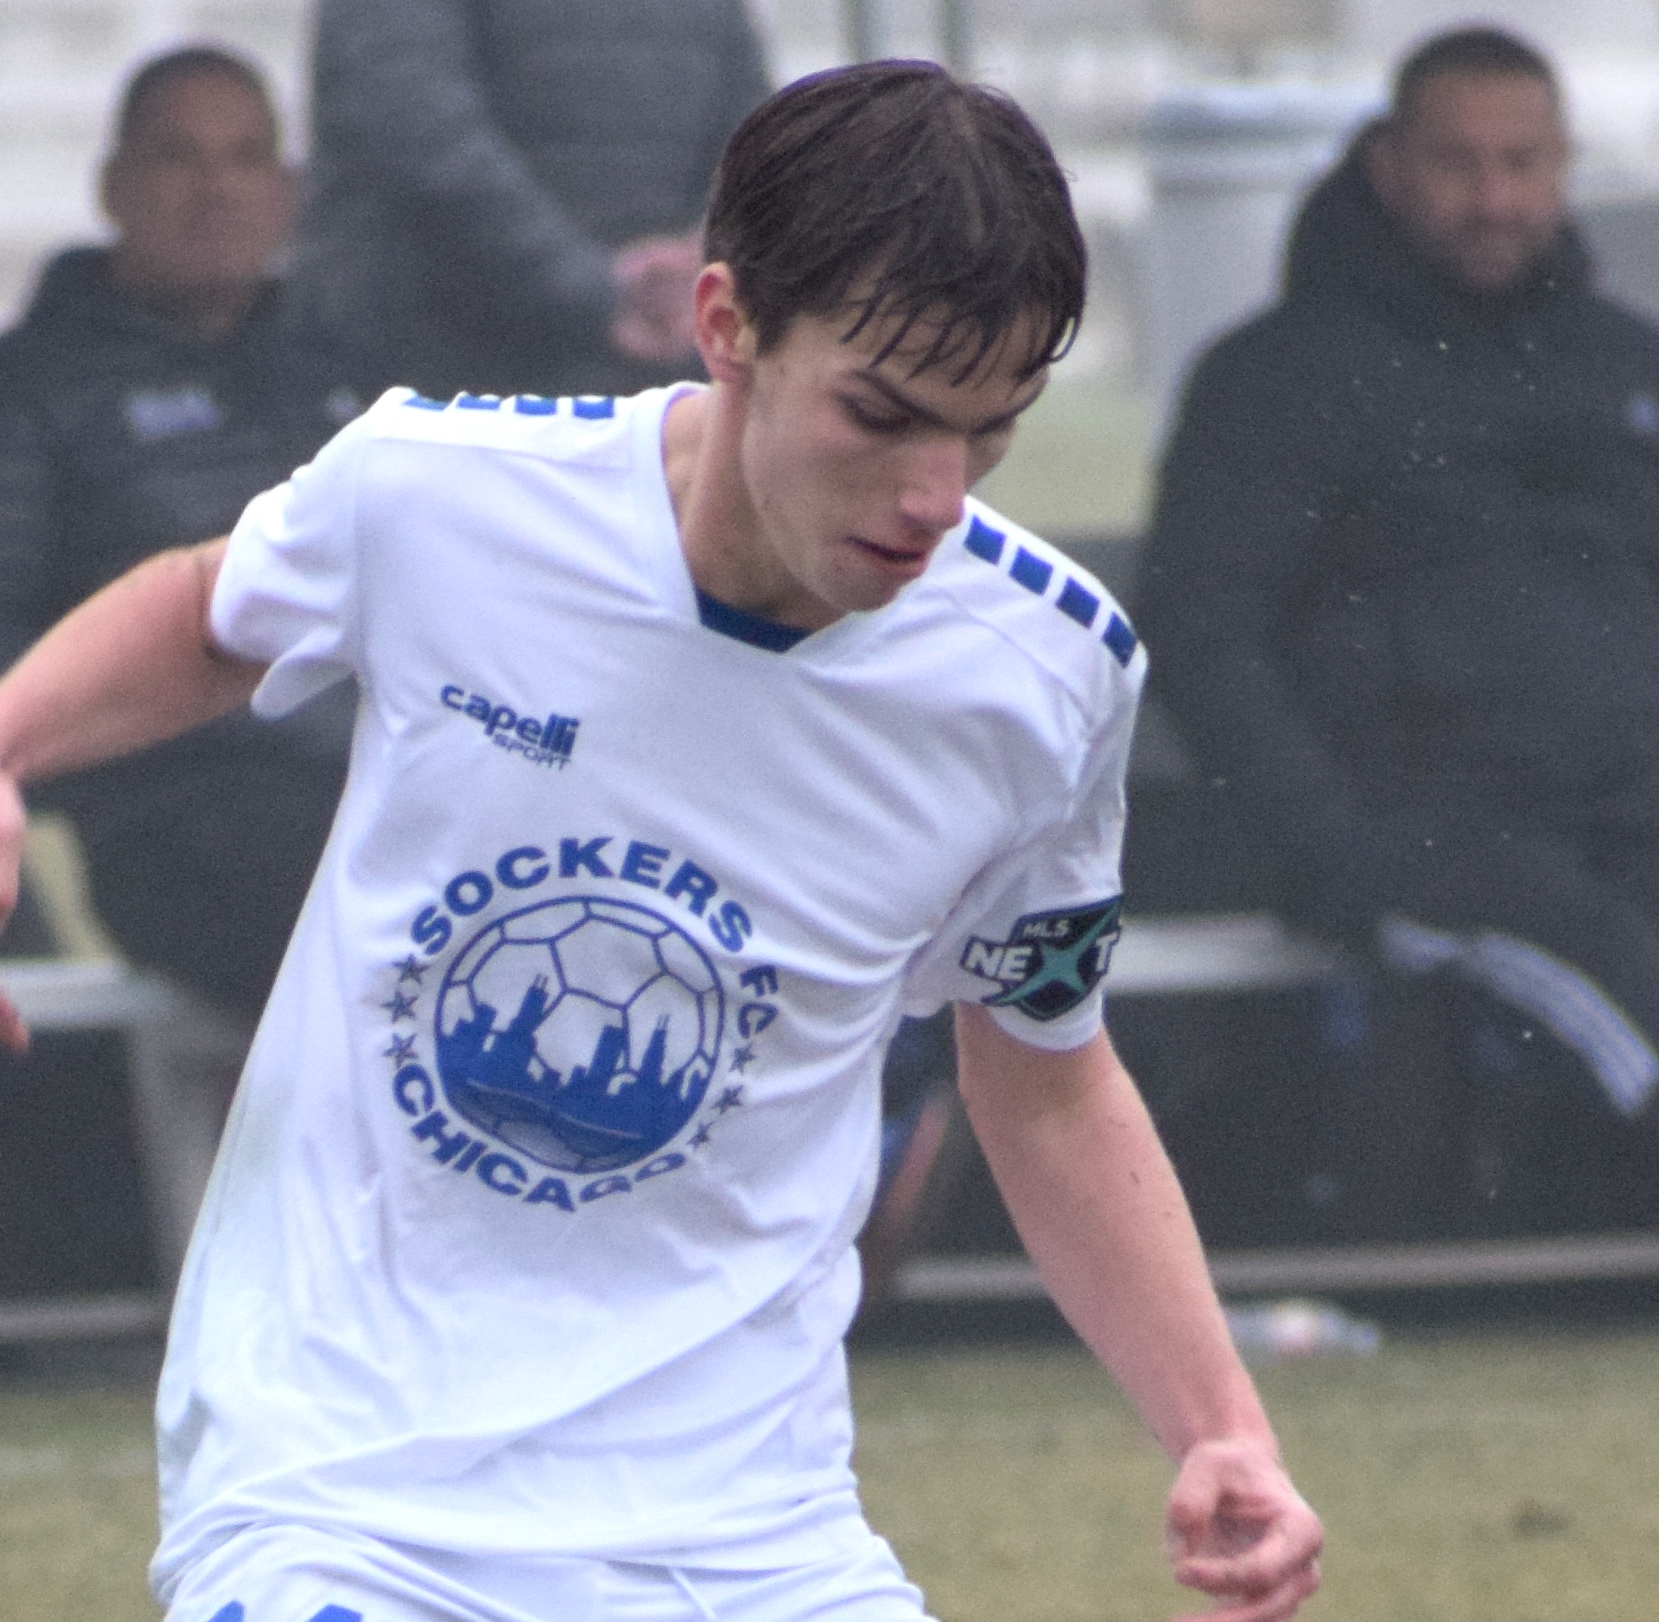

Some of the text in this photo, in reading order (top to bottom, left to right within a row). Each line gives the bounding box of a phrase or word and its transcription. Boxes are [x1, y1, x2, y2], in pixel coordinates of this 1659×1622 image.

[441, 685, 580, 756] capelli
[411, 837, 778, 1038] SOCKERS FC
[1021, 918, 1070, 938] MLS
[392, 1065, 687, 1212] CHICAGO
